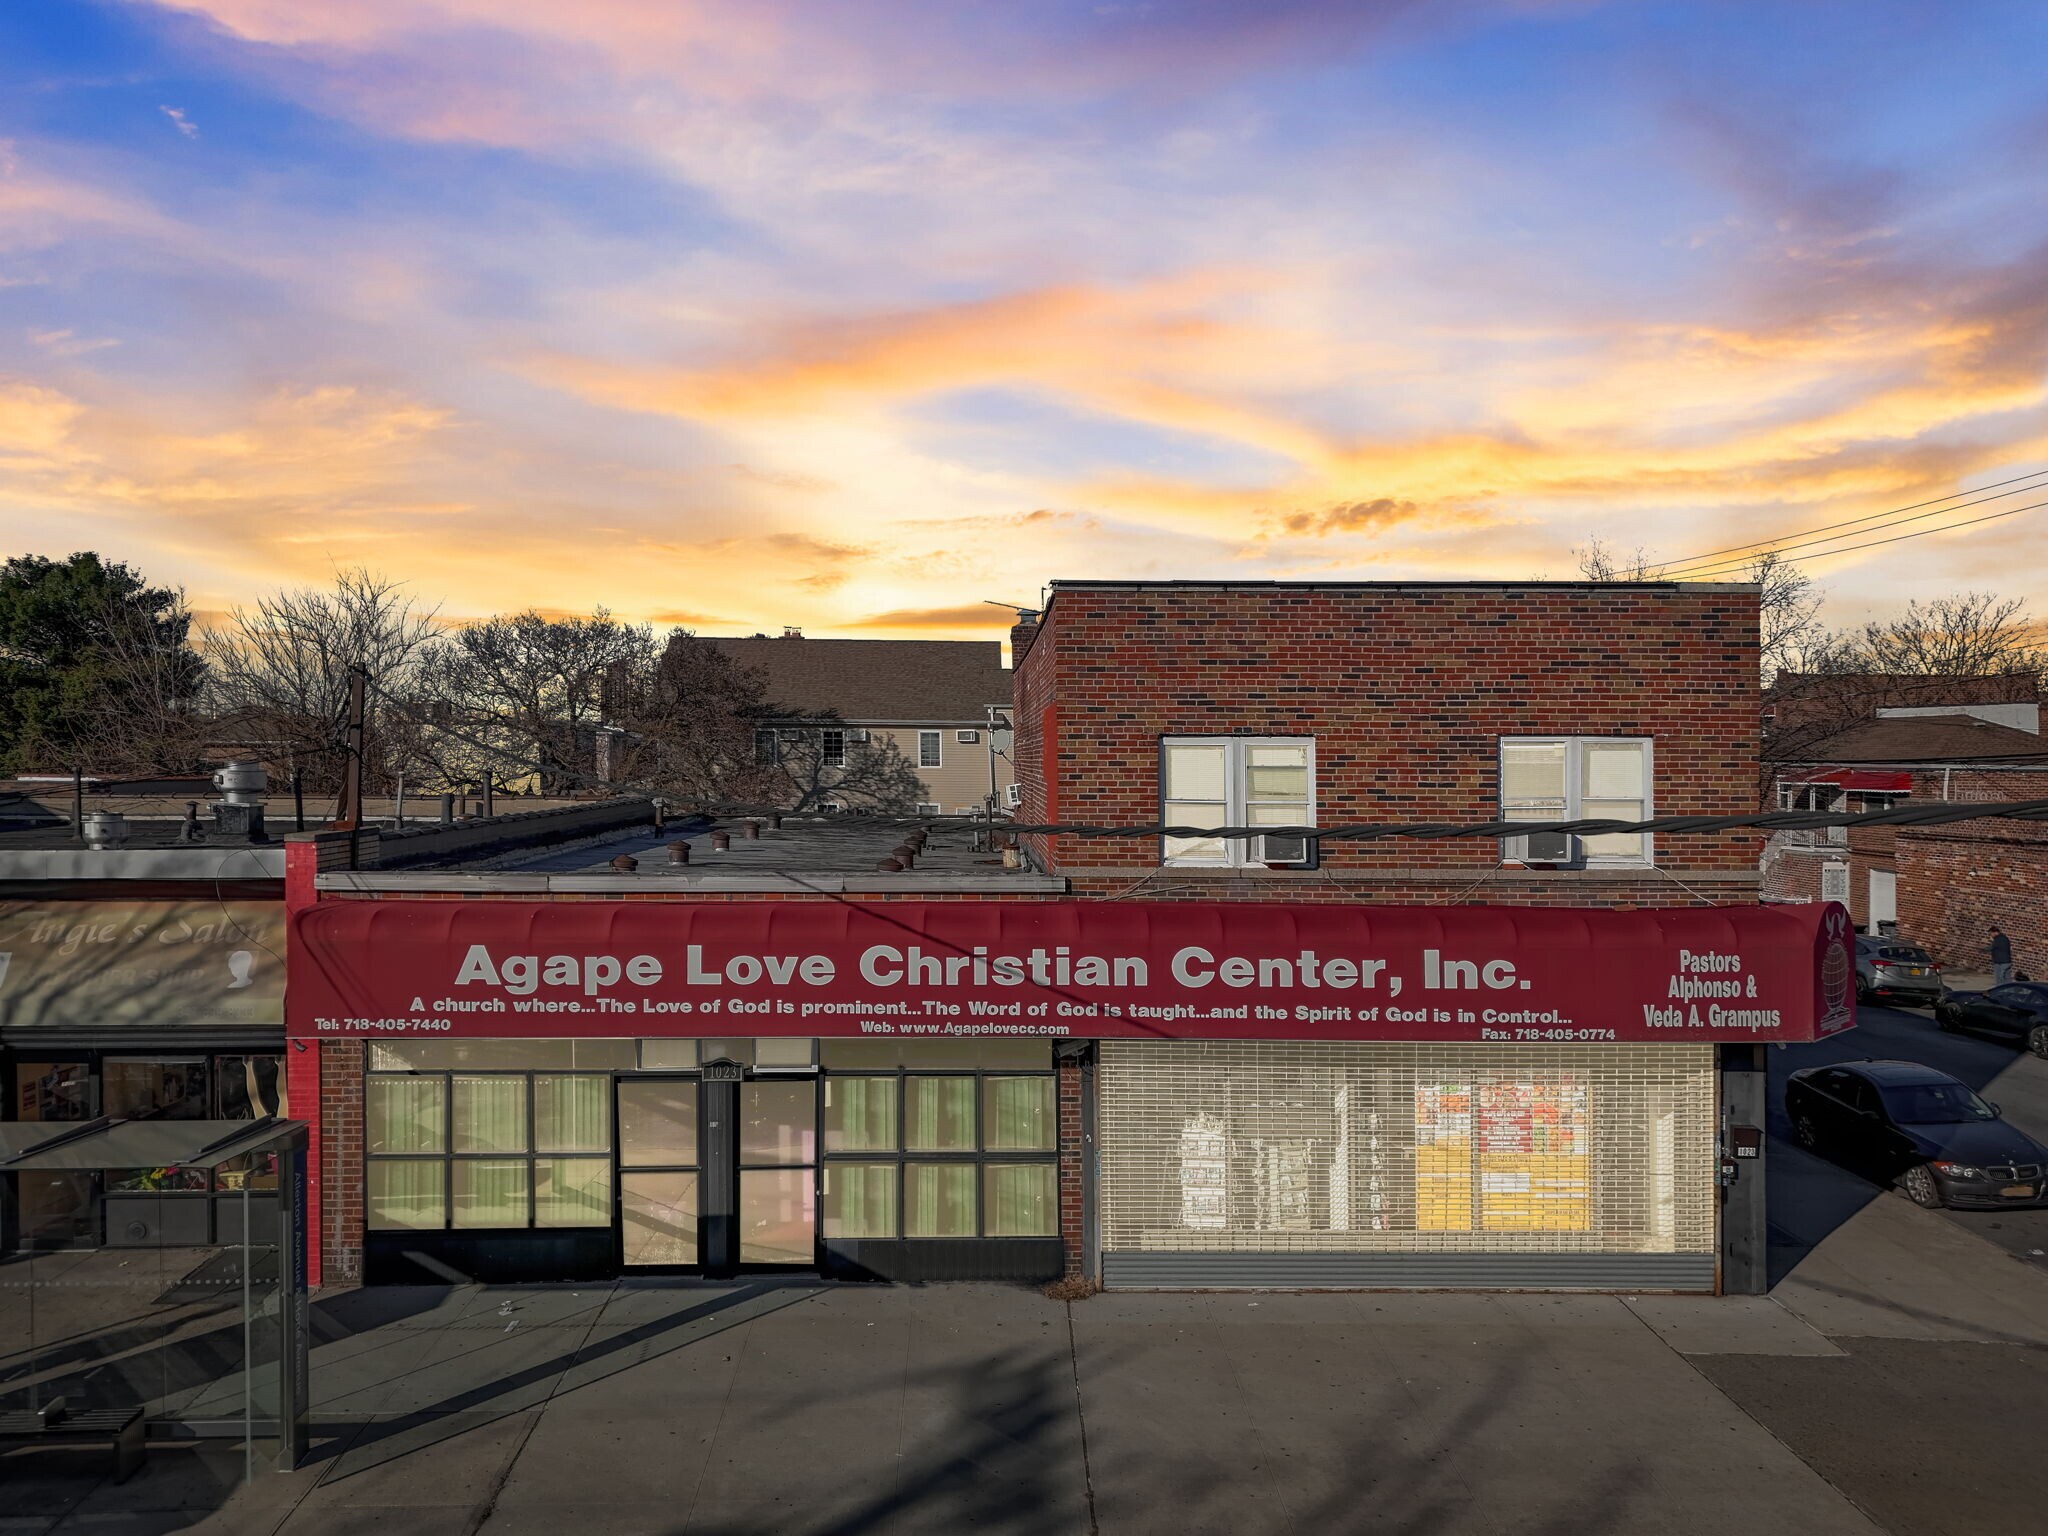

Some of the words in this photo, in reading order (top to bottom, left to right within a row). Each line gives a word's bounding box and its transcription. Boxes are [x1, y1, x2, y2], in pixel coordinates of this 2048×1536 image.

[0, 911, 147, 956] Angies
[454, 944, 663, 996] Agape
[686, 944, 836, 986] Love
[859, 944, 1148, 987] Christian
[1171, 946, 1402, 998] Center,
[1423, 949, 1531, 990] Inc.
[1680, 949, 1741, 973] Pastors
[1668, 974, 1741, 1003] Alphonso
[1746, 974, 1758, 998] &
[410, 997, 425, 1012] A
[433, 998, 506, 1013] church
[643, 999, 693, 1014] Love
[700, 999, 720, 1014] of
[728, 999, 770, 1014] God
[777, 999, 794, 1014] is
[968, 1001, 1021, 1016] Word
[1028, 1002, 1048, 1017] of
[1056, 1002, 1098, 1017] God
[1105, 1003, 1122, 1017] is
[1255, 1005, 1288, 1020] the
[1294, 1006, 1352, 1023] Spirit
[1358, 1007, 1379, 1021] of
[1386, 1007, 1427, 1022] God
[1433, 1008, 1451, 1023] is
[1458, 1008, 1476, 1023] in
[1482, 1008, 1573, 1024] Control...
[1643, 1004, 1683, 1028] Veda
[1688, 1004, 1704, 1028] A.
[1708, 1003, 1781, 1033] Grampus
[314, 1017, 340, 1030] Tel:
[344, 1018, 451, 1031] 718-405-7440
[860, 1021, 895, 1033] Web:
[899, 1022, 1070, 1036] www.Agapelovecc.com
[1481, 1028, 1512, 1040] Fax:
[1515, 1028, 1616, 1040] 718-405-0774
[709, 1065, 737, 1079] 1023
